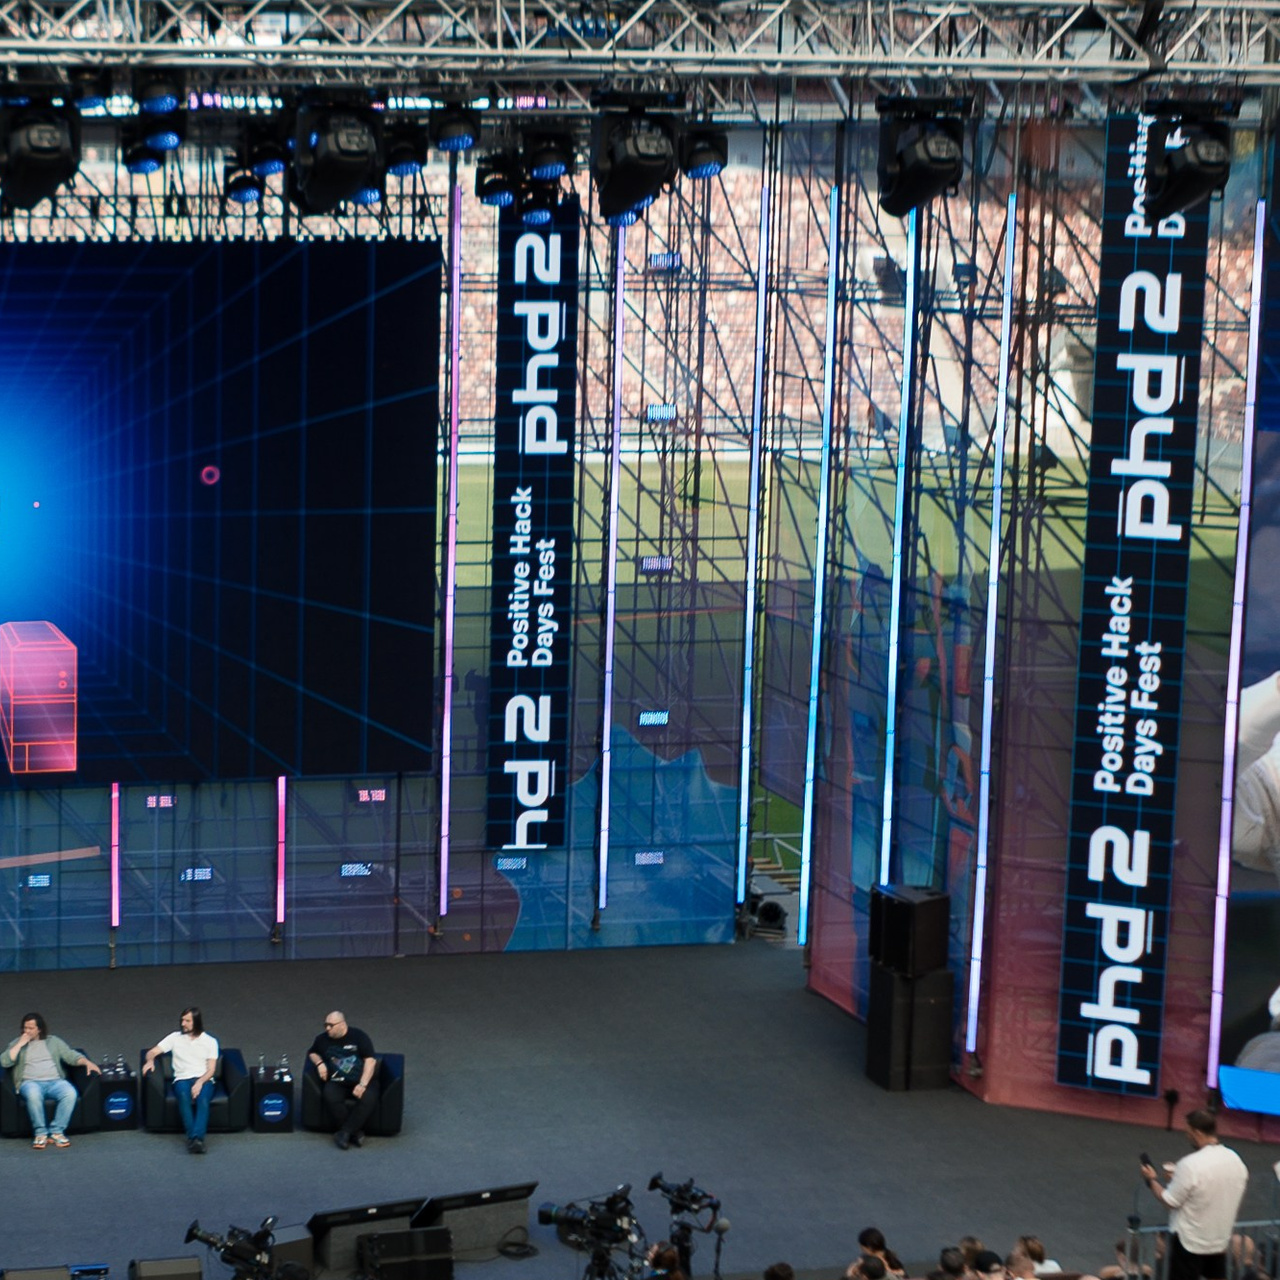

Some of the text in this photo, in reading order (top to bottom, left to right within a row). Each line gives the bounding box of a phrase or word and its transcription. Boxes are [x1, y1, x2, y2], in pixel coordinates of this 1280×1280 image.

[512, 233, 568, 454] phd 2
[1119, 270, 1182, 333] 2
[1111, 353, 1186, 541] phd
[507, 486, 532, 667] Positive Hack
[532, 538, 558, 666] Days Fest
[502, 695, 555, 850] hd 2
[1094, 575, 1133, 792] Positive Hack
[1125, 641, 1163, 796] Days Fest
[1080, 825, 1153, 1085] phd 2
